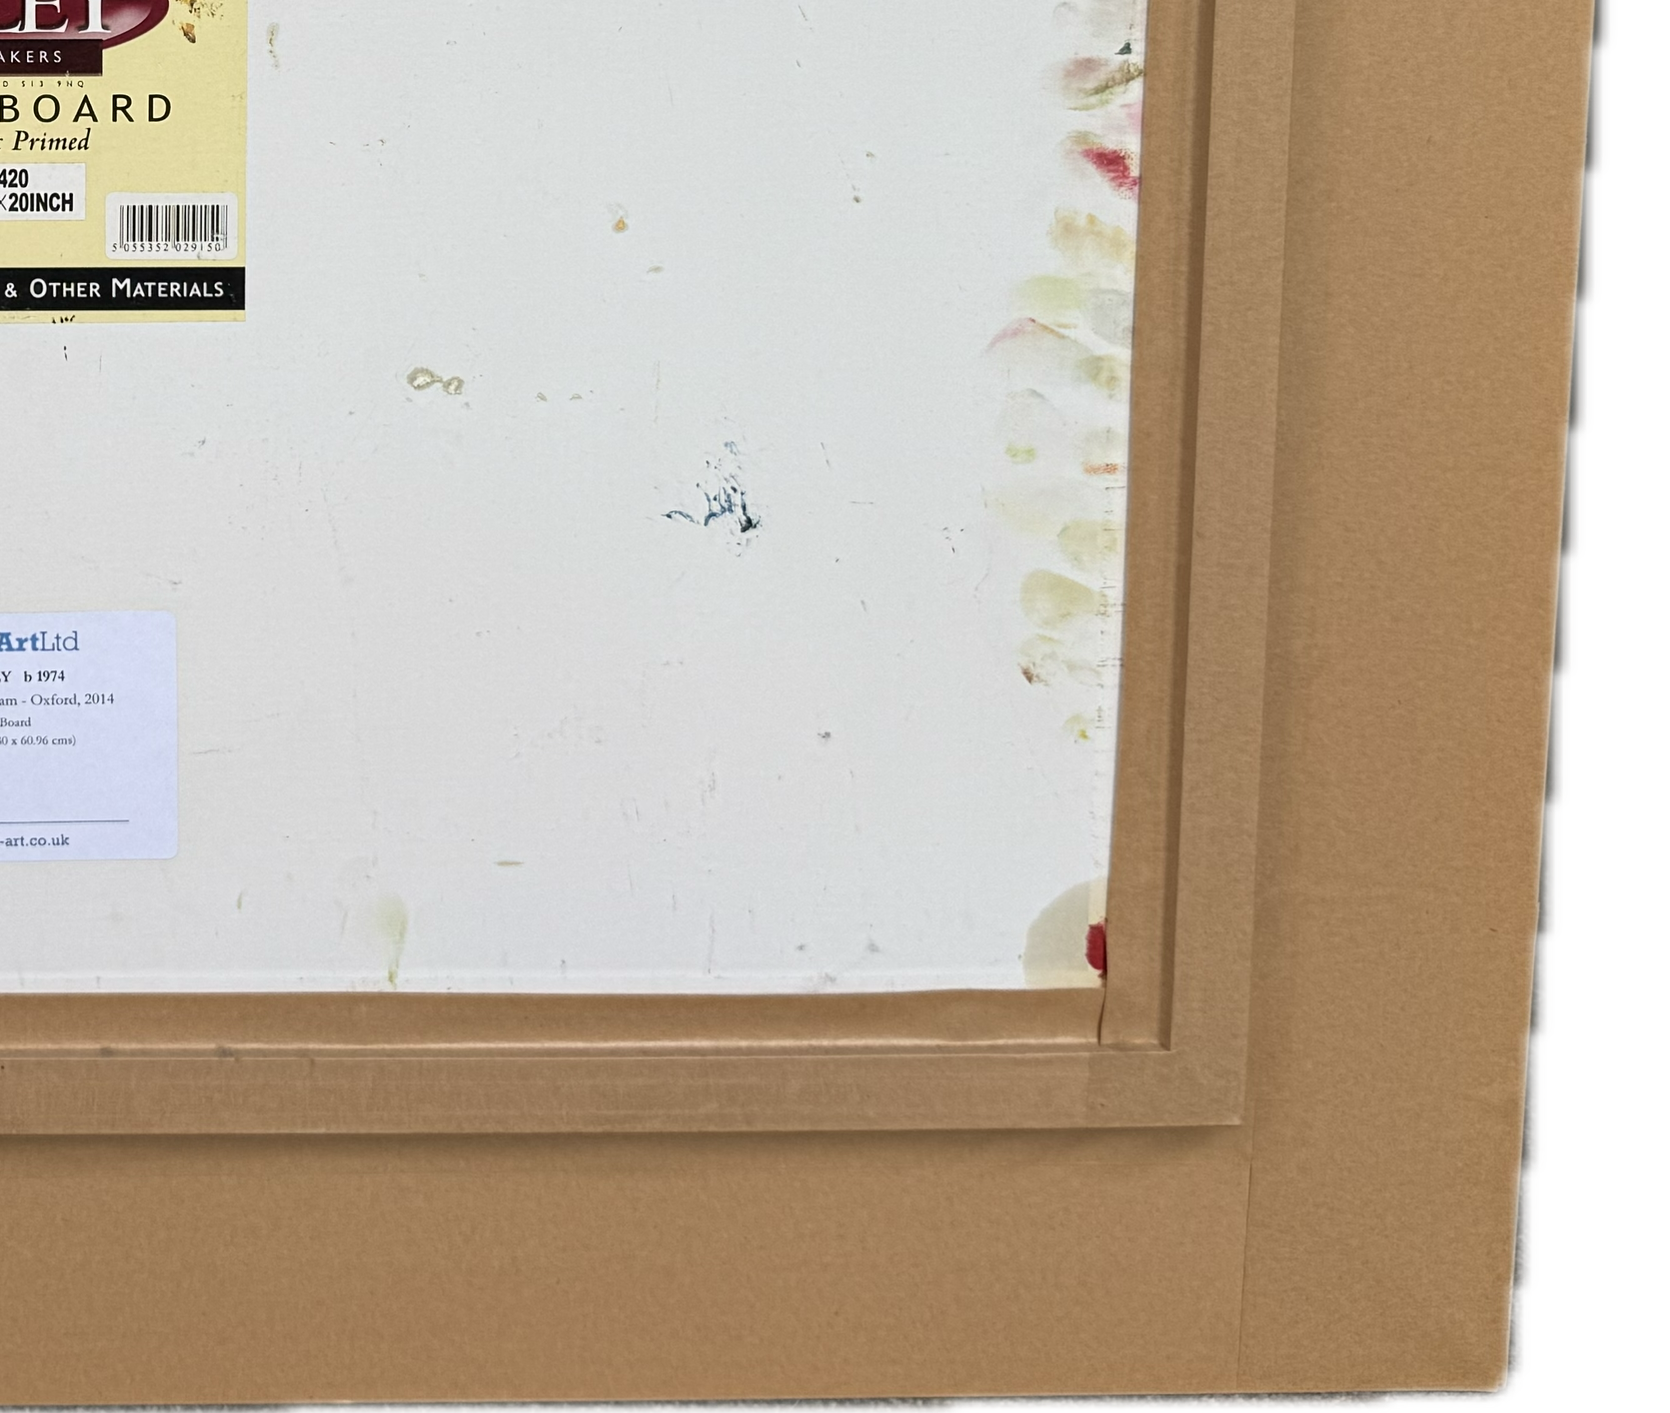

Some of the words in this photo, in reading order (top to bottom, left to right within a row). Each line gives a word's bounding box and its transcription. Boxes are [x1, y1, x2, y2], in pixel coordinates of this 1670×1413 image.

[21, 80, 44, 88] S13
[56, 80, 84, 89] 9NQ
[11, 127, 92, 151] Primed
[4, 282, 18, 298] &
[23, 670, 33, 683] b
[37, 669, 65, 683] 1974
[30, 693, 81, 707] Oxford,
[84, 693, 115, 705] 2014
[0, 716, 32, 728] Board
[11, 738, 18, 746] x
[20, 735, 49, 746] 60.96
[51, 735, 77, 747] cms)
